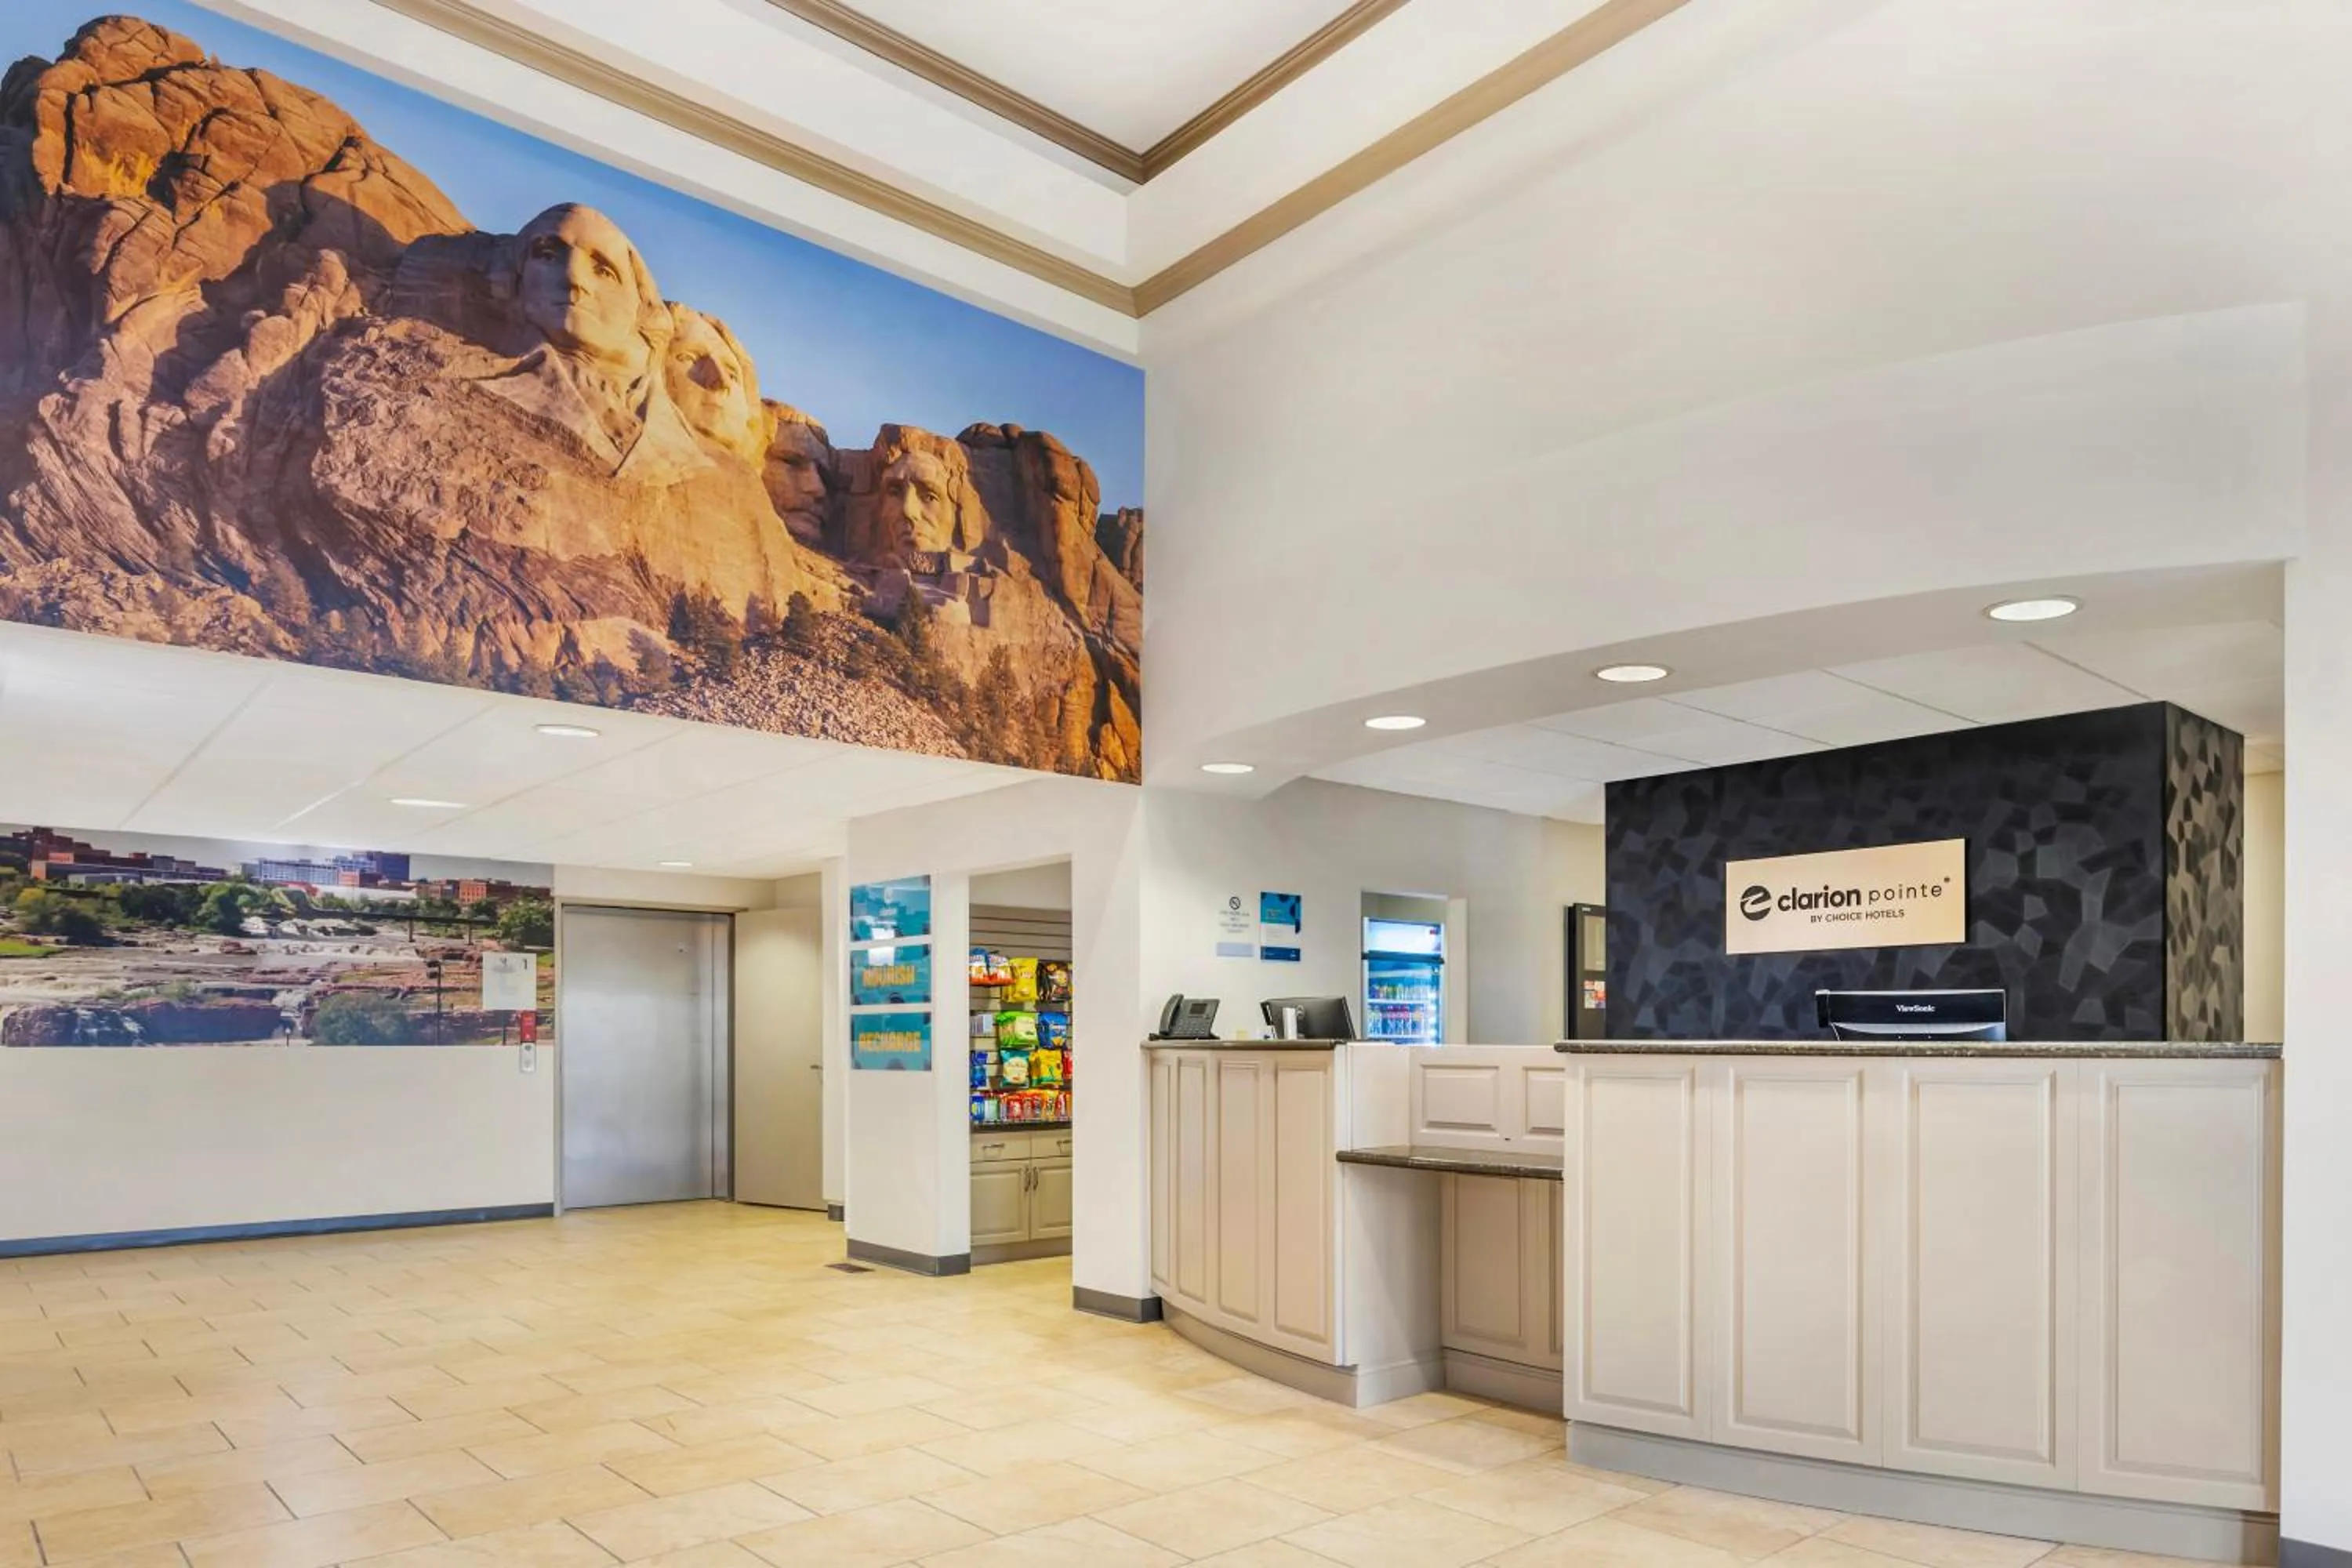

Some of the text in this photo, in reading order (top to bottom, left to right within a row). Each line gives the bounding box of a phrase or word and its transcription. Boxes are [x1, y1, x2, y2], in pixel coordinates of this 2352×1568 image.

[1777, 884, 1942, 912] clarion pointe
[1810, 909, 1904, 923] BY CHOICE HOTELS
